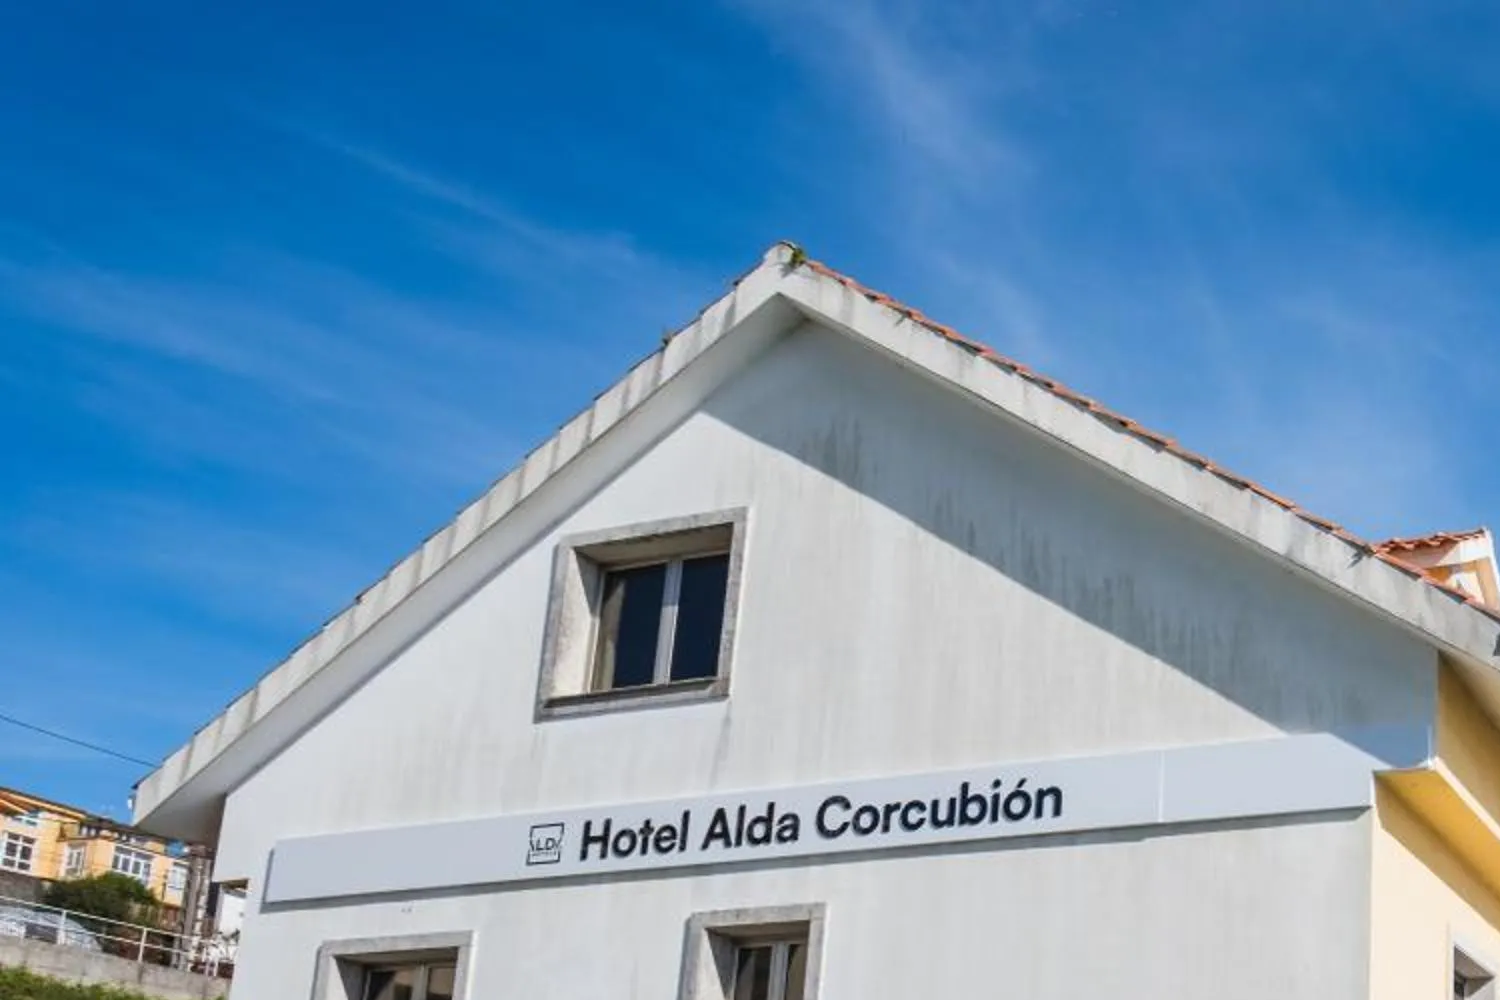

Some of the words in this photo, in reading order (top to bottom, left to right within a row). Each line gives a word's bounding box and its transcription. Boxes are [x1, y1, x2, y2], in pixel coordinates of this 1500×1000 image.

[579, 808, 691, 861] Hotel
[701, 801, 800, 851] Alda
[815, 778, 1063, 839] Corcubión
